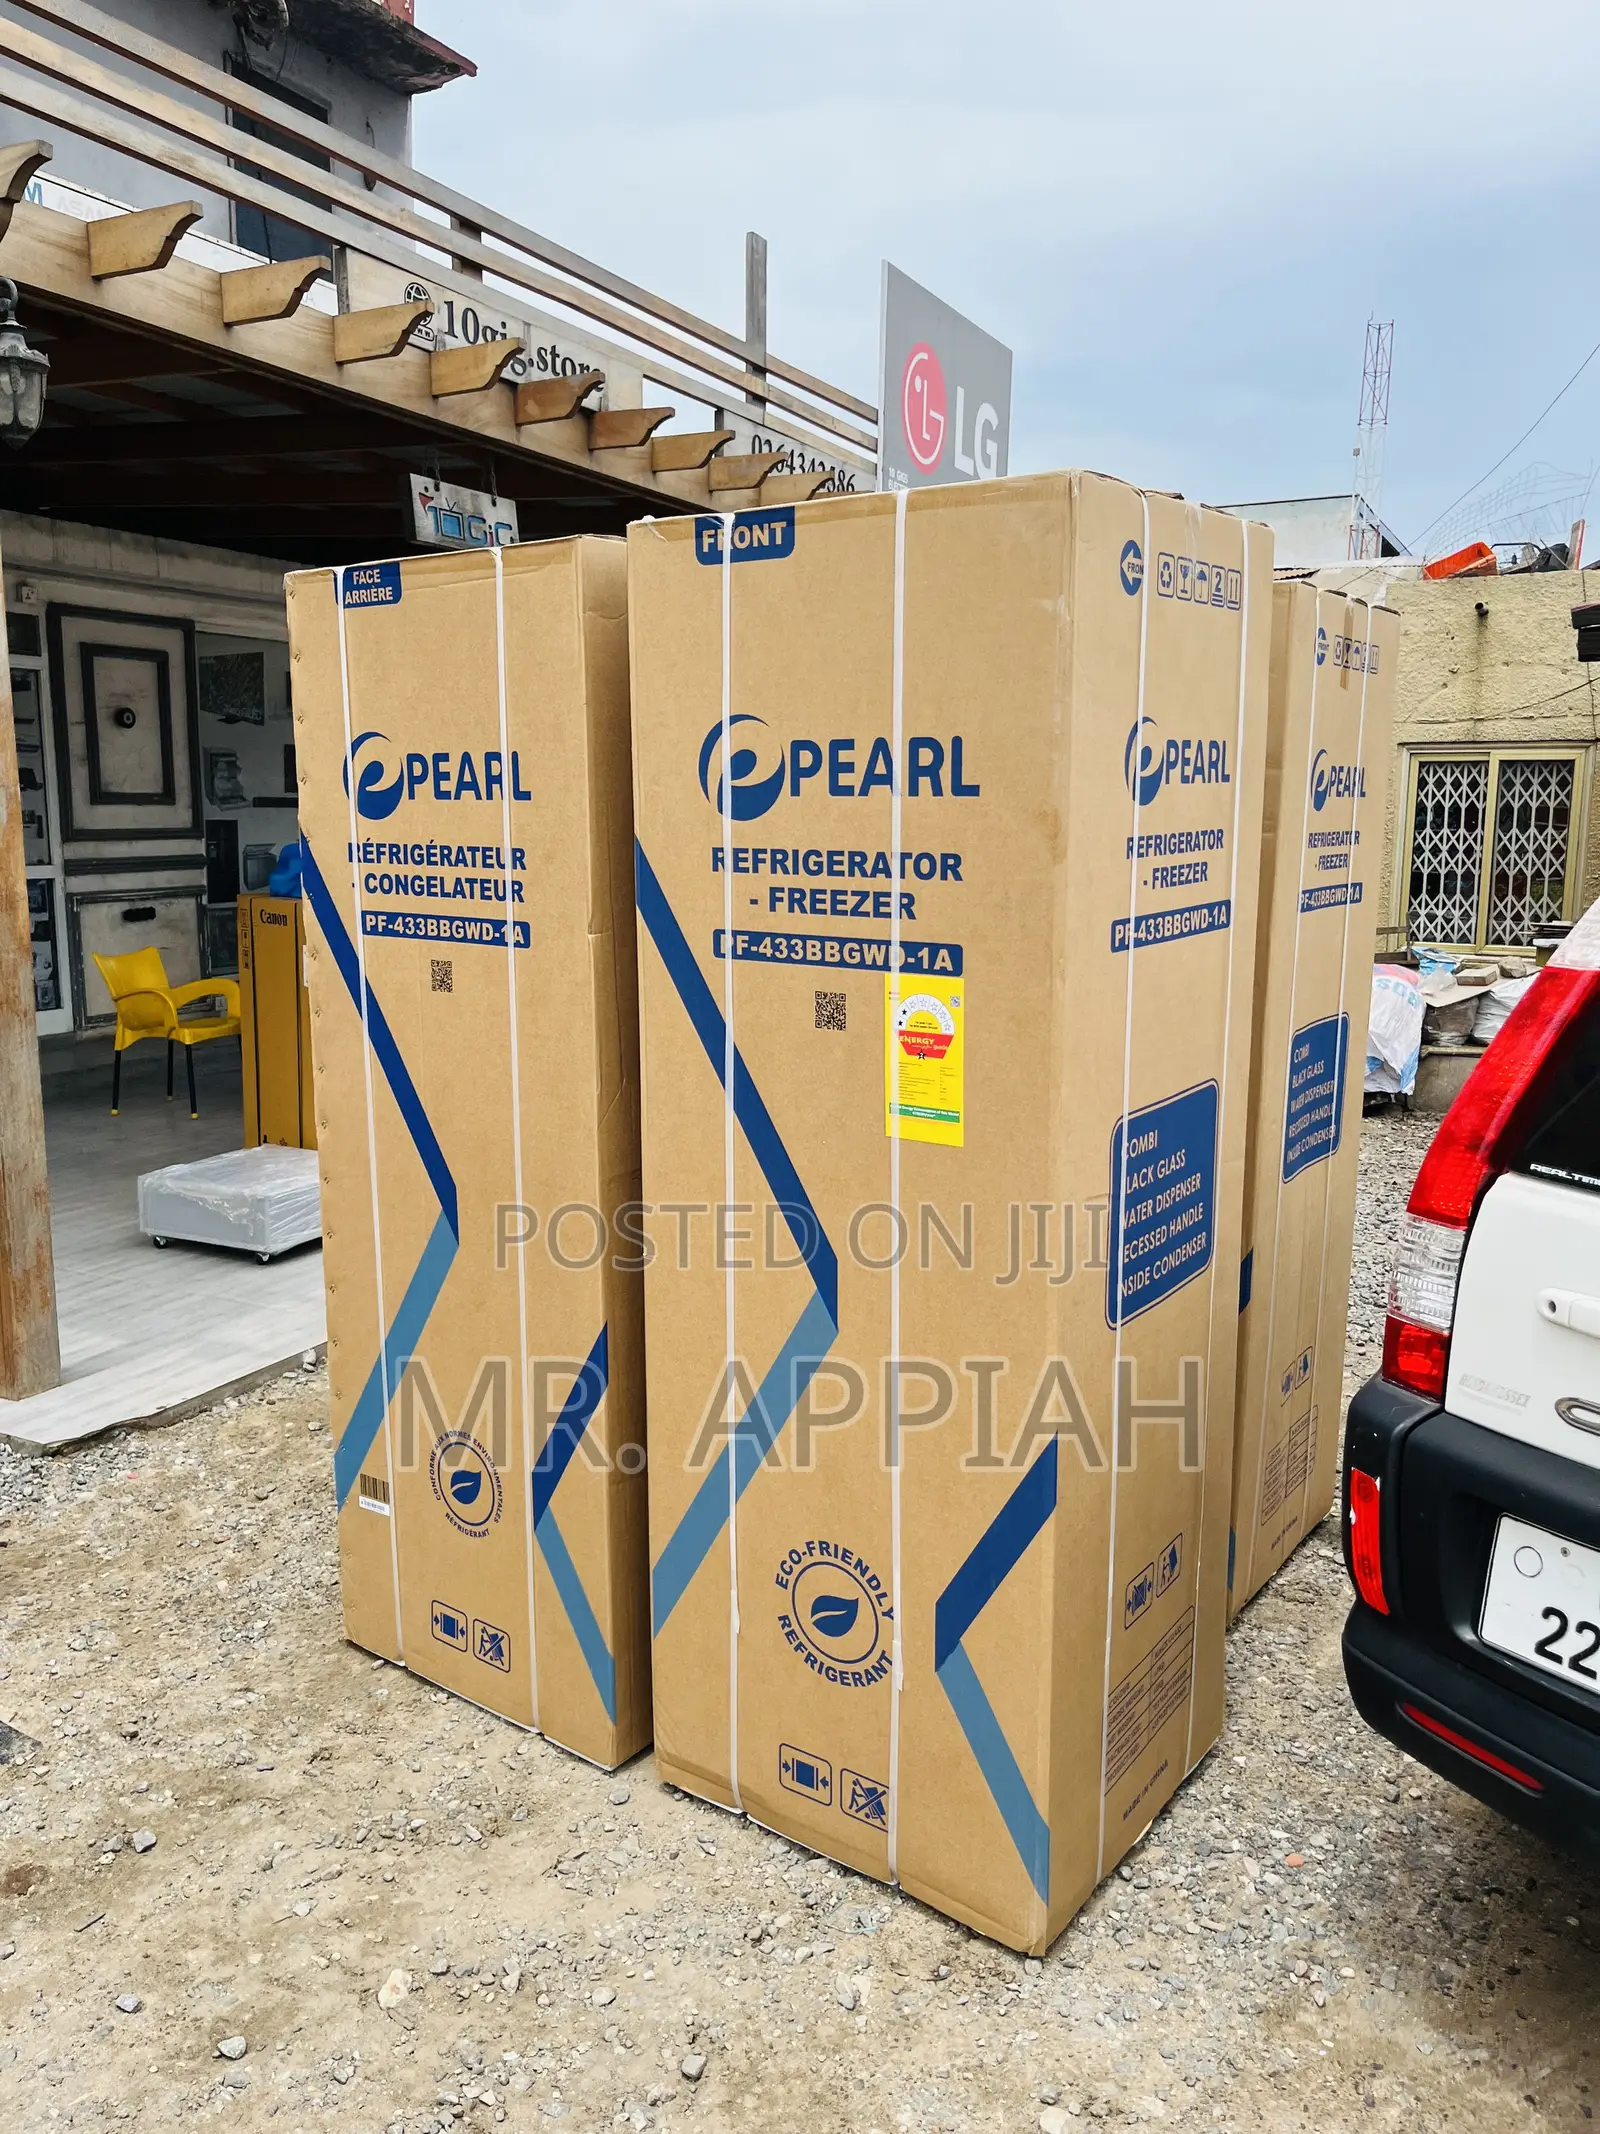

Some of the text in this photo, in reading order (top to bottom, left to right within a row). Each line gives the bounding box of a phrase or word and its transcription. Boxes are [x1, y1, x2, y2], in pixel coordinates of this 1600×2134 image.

[954, 385, 999, 481] LG
[702, 521, 787, 553] FRONT
[352, 569, 381, 585] FACE
[1127, 562, 1145, 576] FRON
[344, 585, 394, 605] ARRIÈRE
[406, 751, 532, 801] PEARL
[789, 735, 981, 797] PEARL
[1165, 739, 1230, 785] PEARL
[347, 837, 528, 871] RÉFRIGÉRATEUR
[1126, 828, 1225, 860] REFRIGERATOR
[1307, 830, 1361, 849] REFRIGERATOR
[711, 846, 964, 882] REFRIGERATOR
[1151, 861, 1209, 890] FREEZER
[1317, 853, 1349, 872] FREEZER
[364, 872, 525, 904] CONGELATEUR
[768, 886, 917, 921] FREEZER
[260, 909, 288, 927] Canon
[365, 914, 525, 945] PF-433BBGWD-1A
[1115, 904, 1228, 948] PF-433BBGWD-1A
[719, 933, 954, 972] PF-433BBGWD-1A
[1126, 1149, 1187, 1195] LACK GLASS
[1155, 1172, 1202, 1214] DISPENSER
[1124, 1202, 1205, 1264] ECESSED HANDLE
[1121, 1231, 1208, 1298] NSIDE CONDENSER
[434, 1437, 444, 1450] AUX
[443, 1430, 472, 1442] NORMES
[429, 1449, 442, 1501] CONFORME
[774, 1540, 894, 1622] ECO-FRIENDLY
[777, 1614, 894, 1688] REFRIGERANT
[1533, 1606, 1600, 1681] 22
